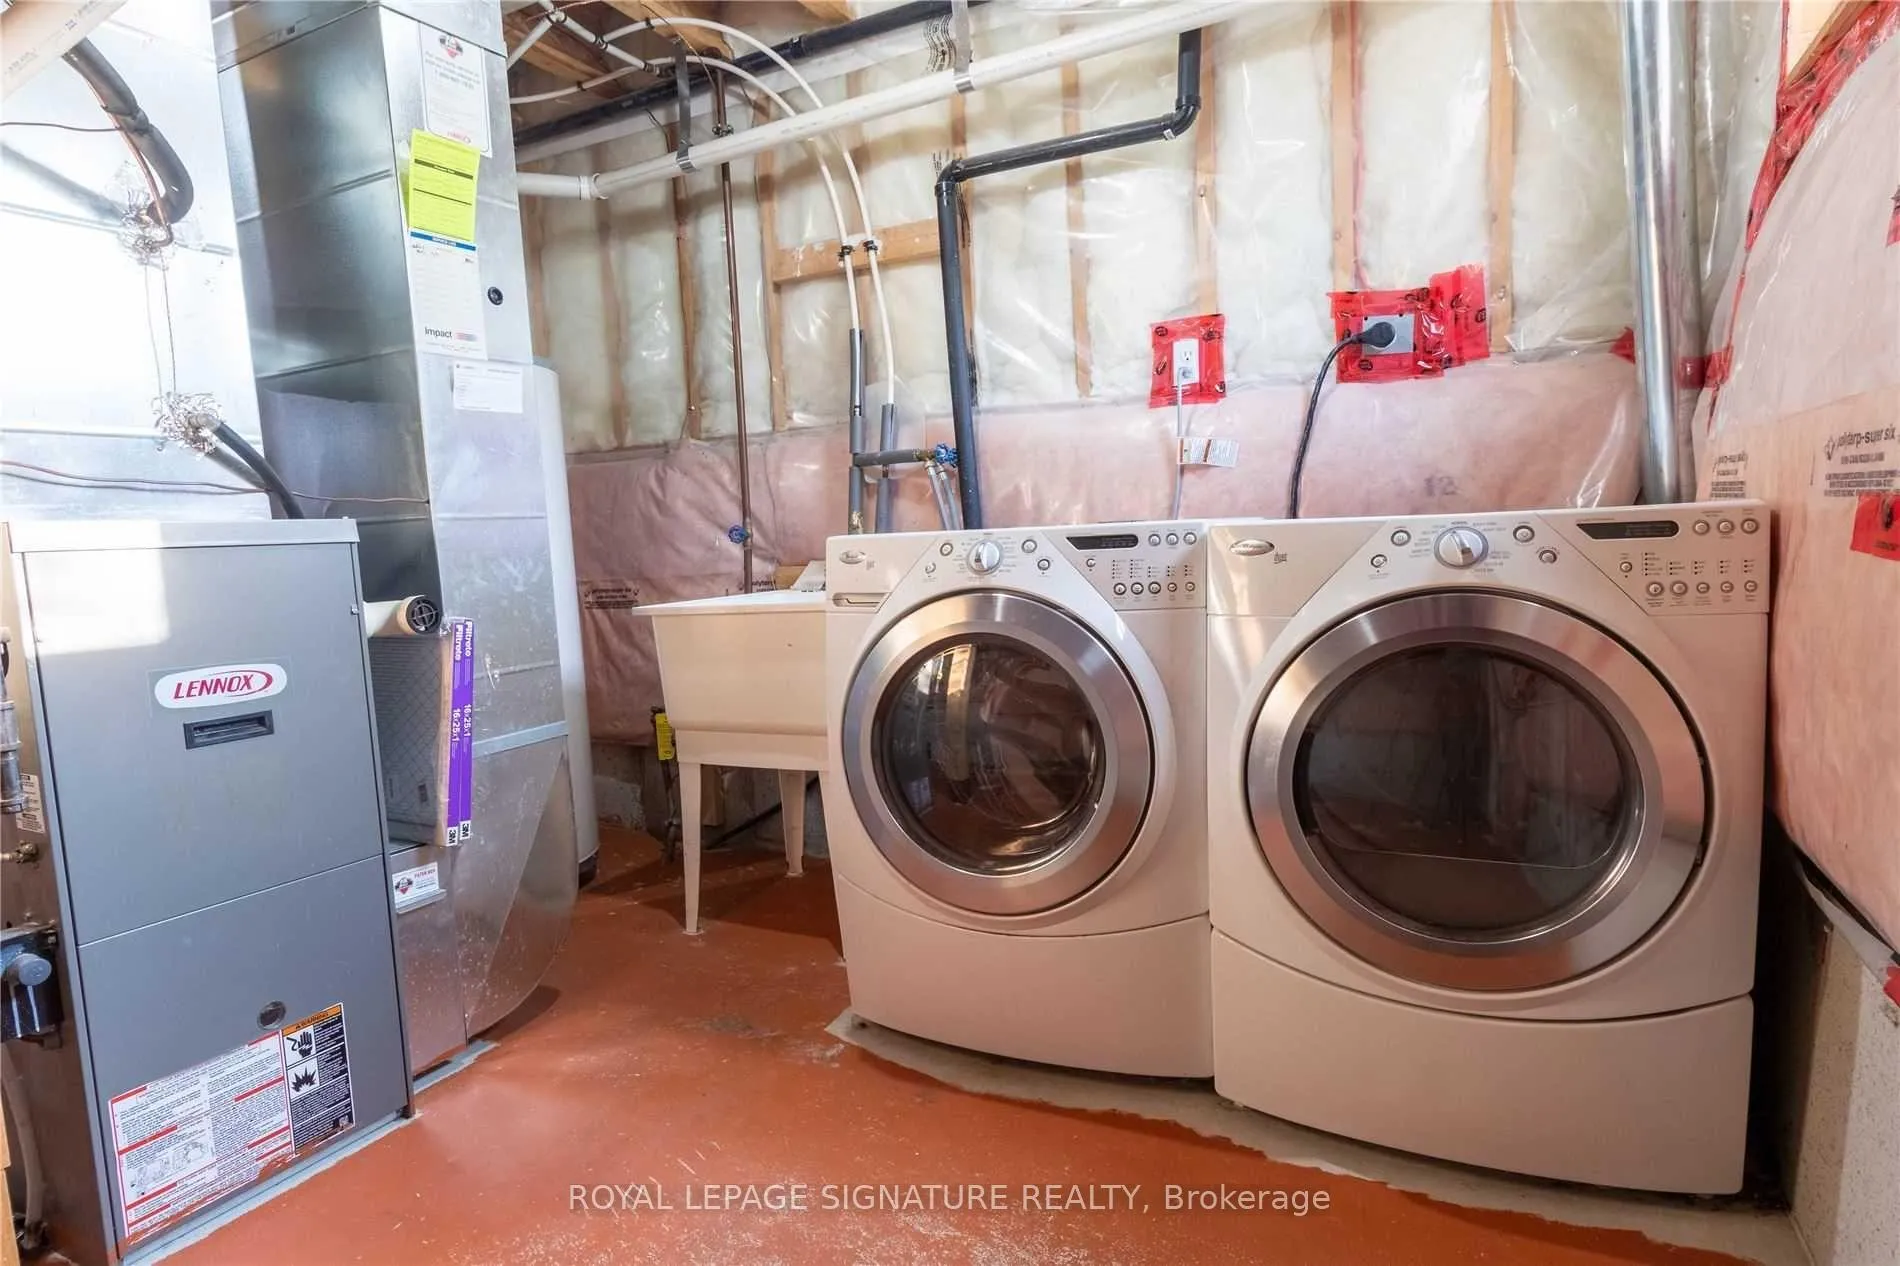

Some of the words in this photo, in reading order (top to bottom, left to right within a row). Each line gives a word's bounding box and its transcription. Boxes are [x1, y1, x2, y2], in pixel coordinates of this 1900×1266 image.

[425, 326, 452, 339] Impact
[173, 674, 254, 700] LENNOX
[448, 829, 456, 844] 3M
[461, 823, 469, 838] 3M
